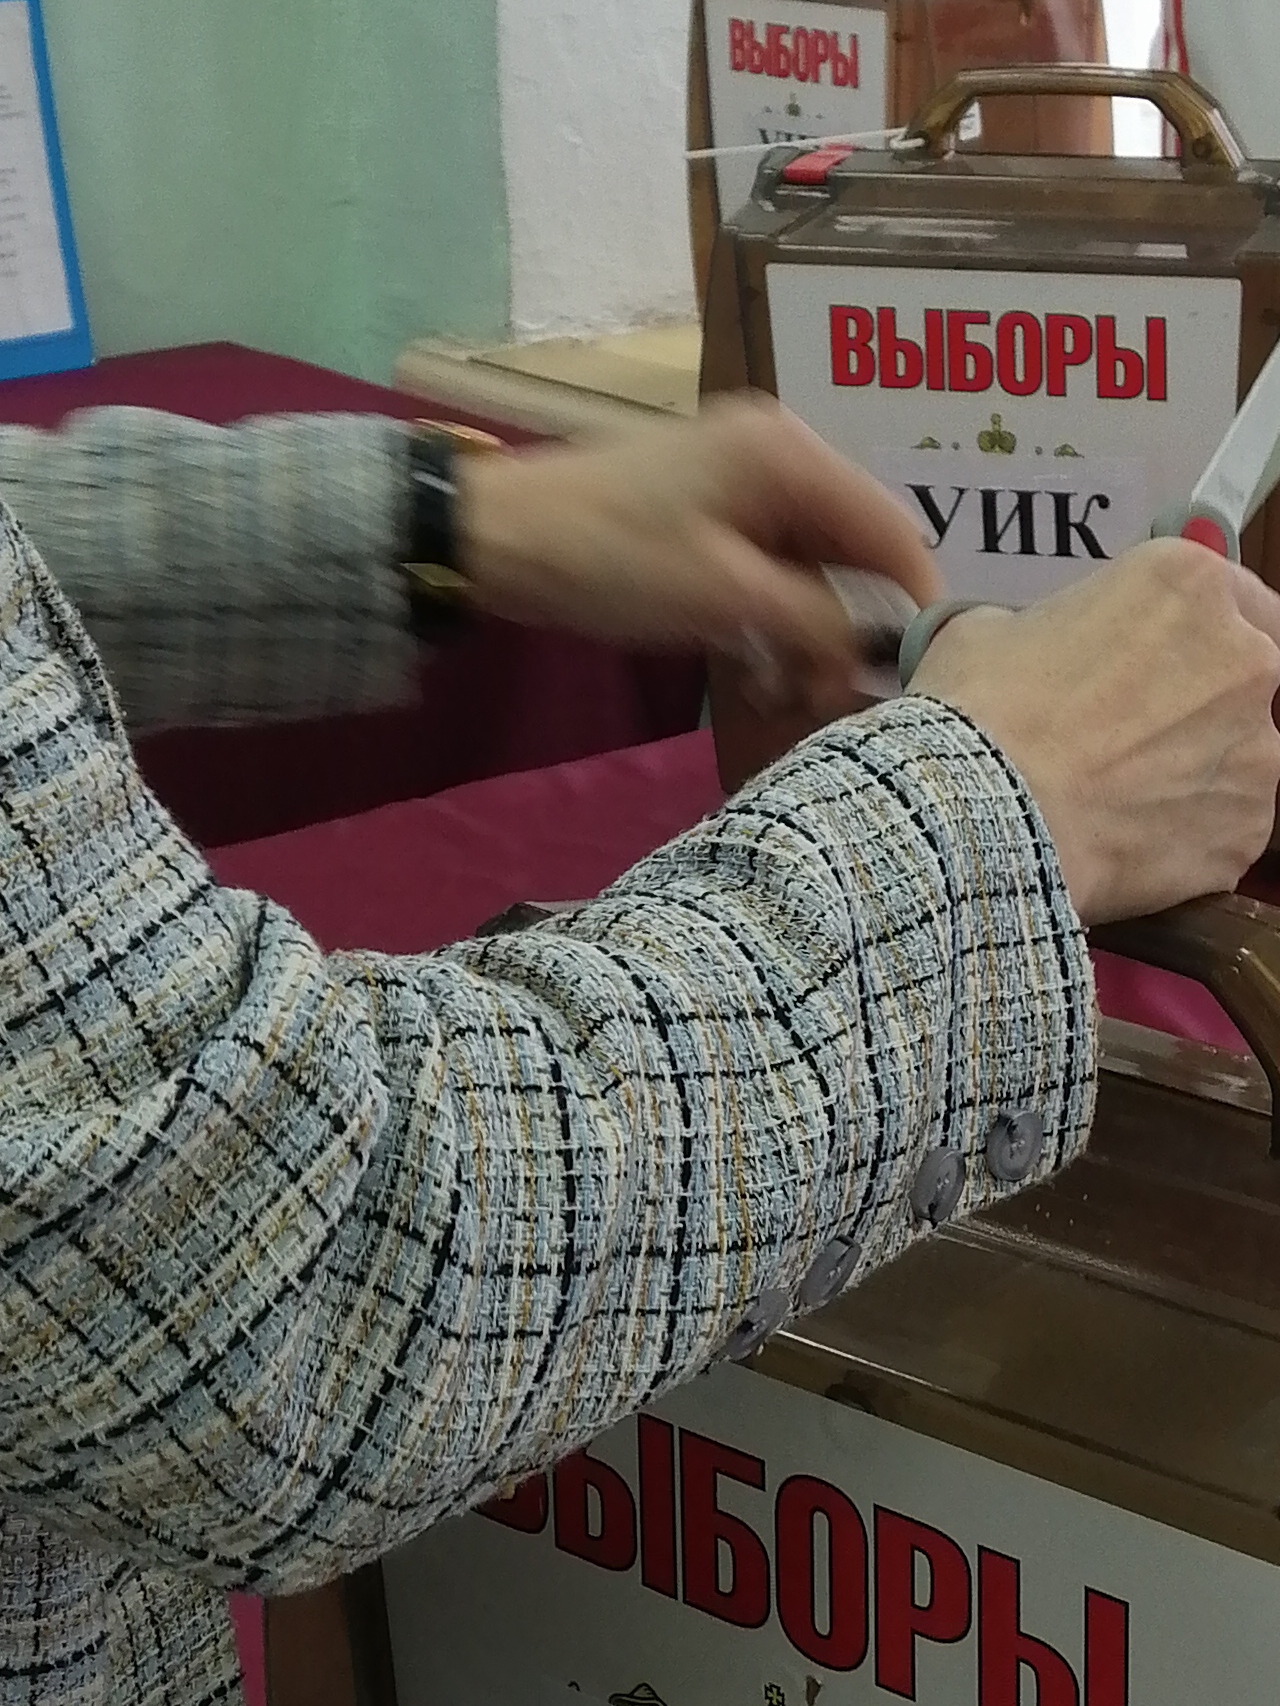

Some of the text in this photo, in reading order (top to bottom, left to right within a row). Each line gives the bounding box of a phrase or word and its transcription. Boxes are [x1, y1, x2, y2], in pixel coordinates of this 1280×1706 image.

[729, 17, 859, 89] ВЫБОРЫ
[829, 304, 1169, 402] ВЫБОРЫ
[904, 483, 1113, 560] УИК
